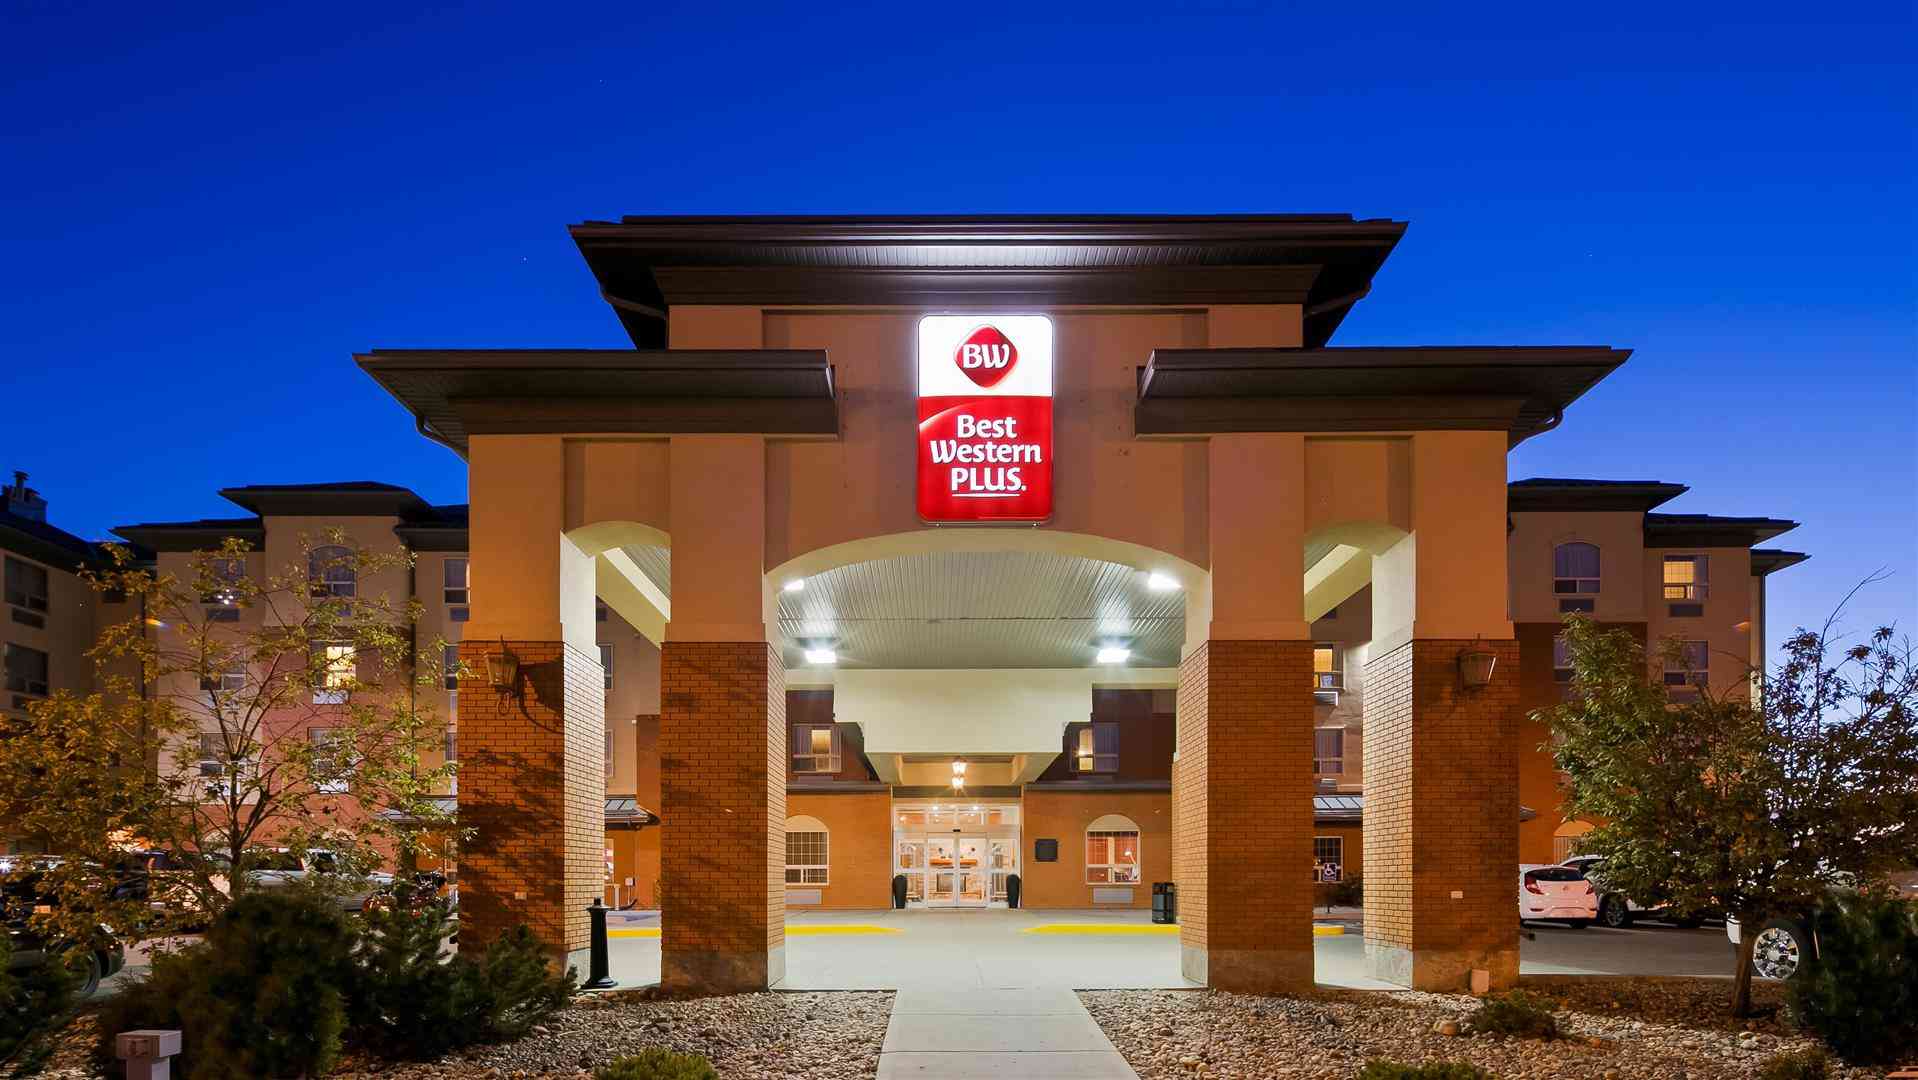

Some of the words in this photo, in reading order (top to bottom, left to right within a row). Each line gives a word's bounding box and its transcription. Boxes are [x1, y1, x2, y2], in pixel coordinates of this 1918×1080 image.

[963, 343, 1010, 369] BW
[957, 414, 1017, 438] Best
[930, 439, 1042, 464] Western
